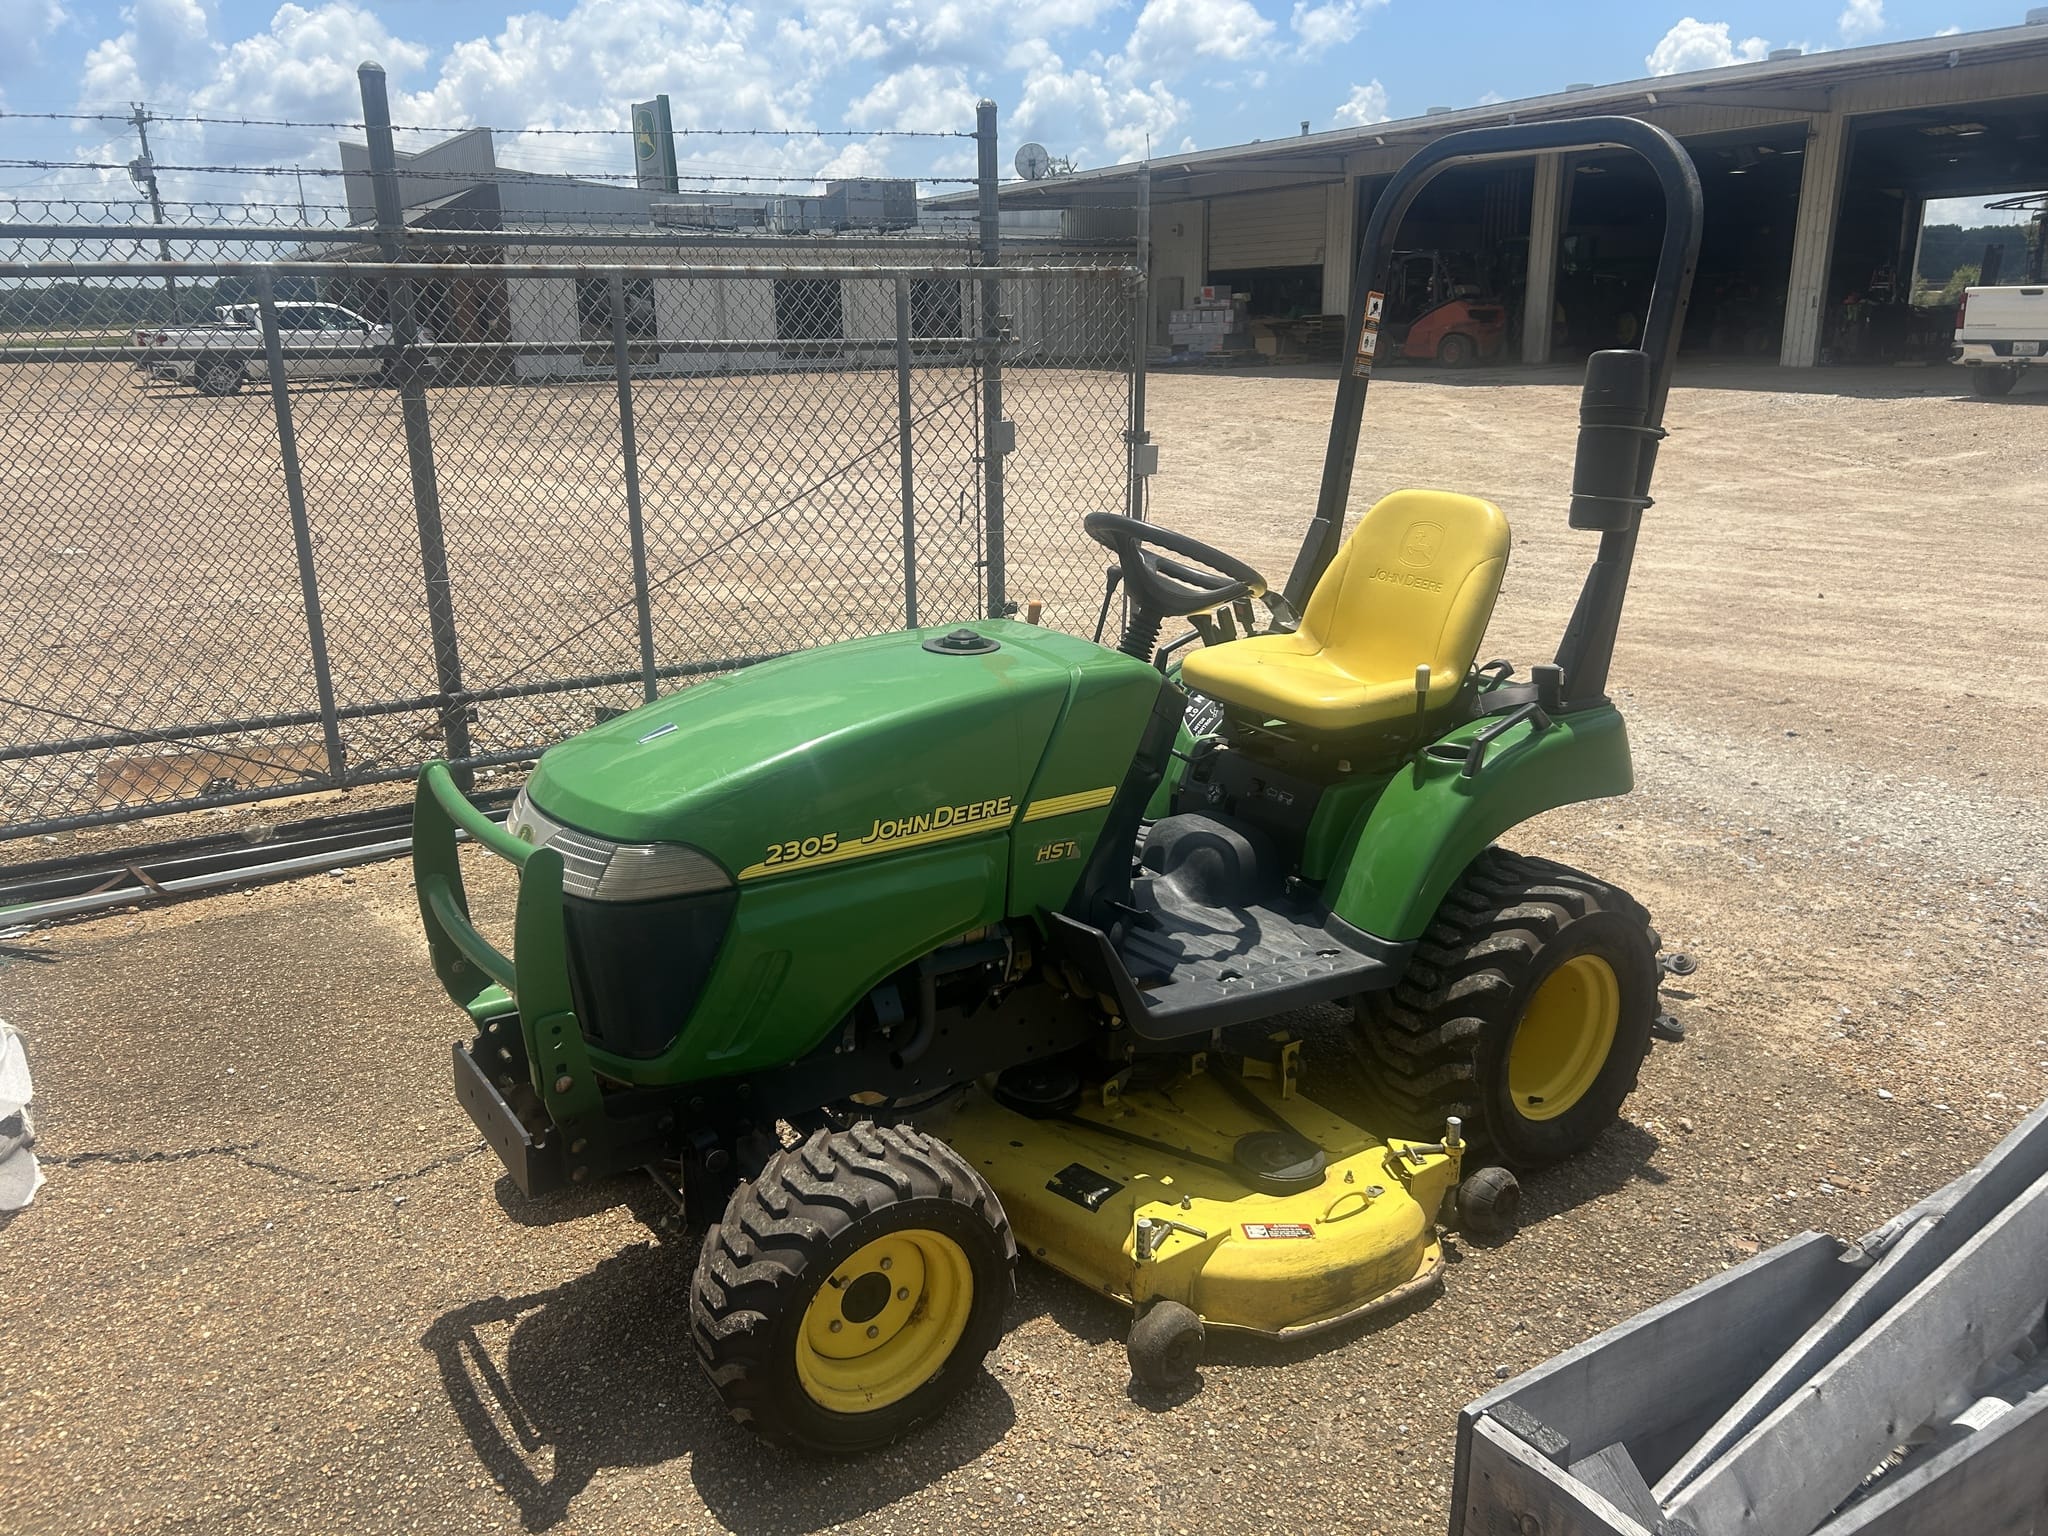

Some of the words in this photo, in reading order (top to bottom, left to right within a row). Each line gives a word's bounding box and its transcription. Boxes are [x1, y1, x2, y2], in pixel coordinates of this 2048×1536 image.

[1368, 567, 1405, 585] JOHN
[1405, 573, 1443, 594] DEERE
[861, 812, 931, 844] JOHN
[931, 795, 1012, 830] DEERE
[764, 832, 838, 865] 2305
[1036, 841, 1076, 862] HST
